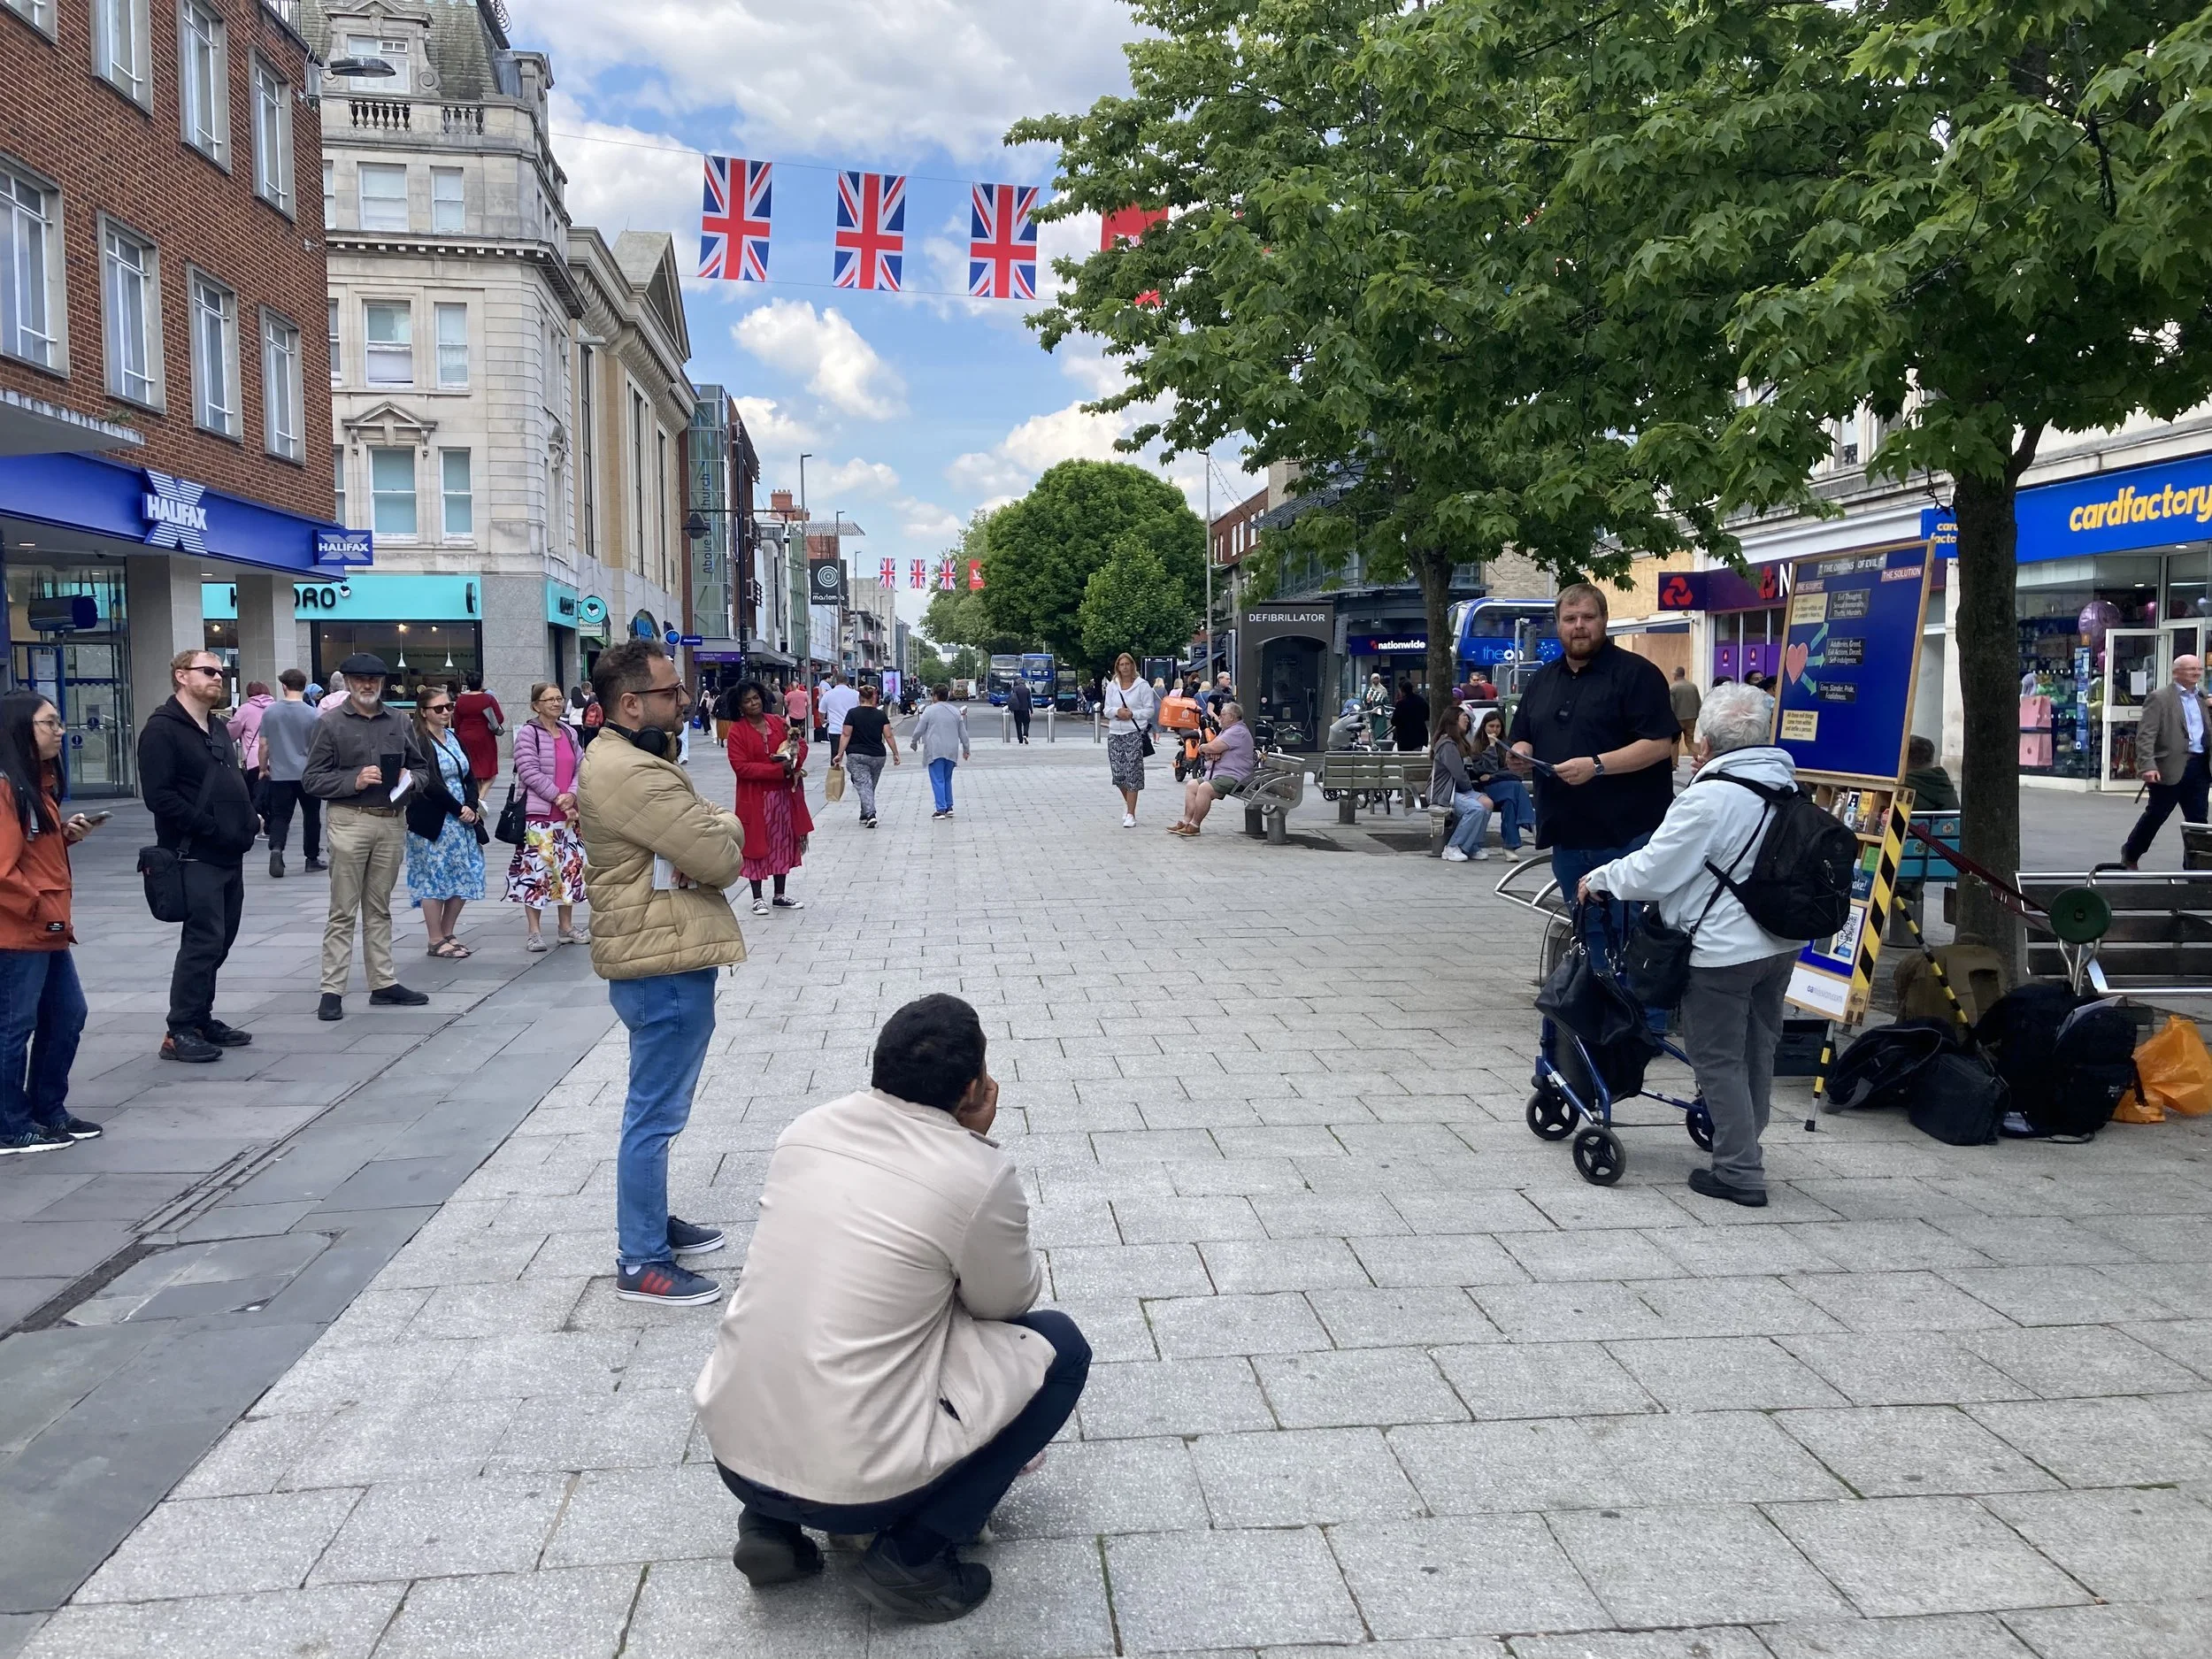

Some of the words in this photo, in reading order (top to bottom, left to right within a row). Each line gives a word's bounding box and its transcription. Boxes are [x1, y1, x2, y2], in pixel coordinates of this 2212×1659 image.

[700, 473, 710, 512] hurch
[148, 495, 208, 531] HALIFAX
[2070, 483, 2212, 532] cardfactory
[1931, 532, 1957, 543] facto
[319, 542, 370, 552] HALIFAX
[702, 540, 712, 573] Above
[1865, 558, 1878, 567] EVIL
[1893, 567, 1922, 579] SOLUTION
[1248, 613, 1325, 622] DEFIBRILLATOR
[1378, 640, 1425, 650] nationwide
[1847, 794, 1860, 809] A
